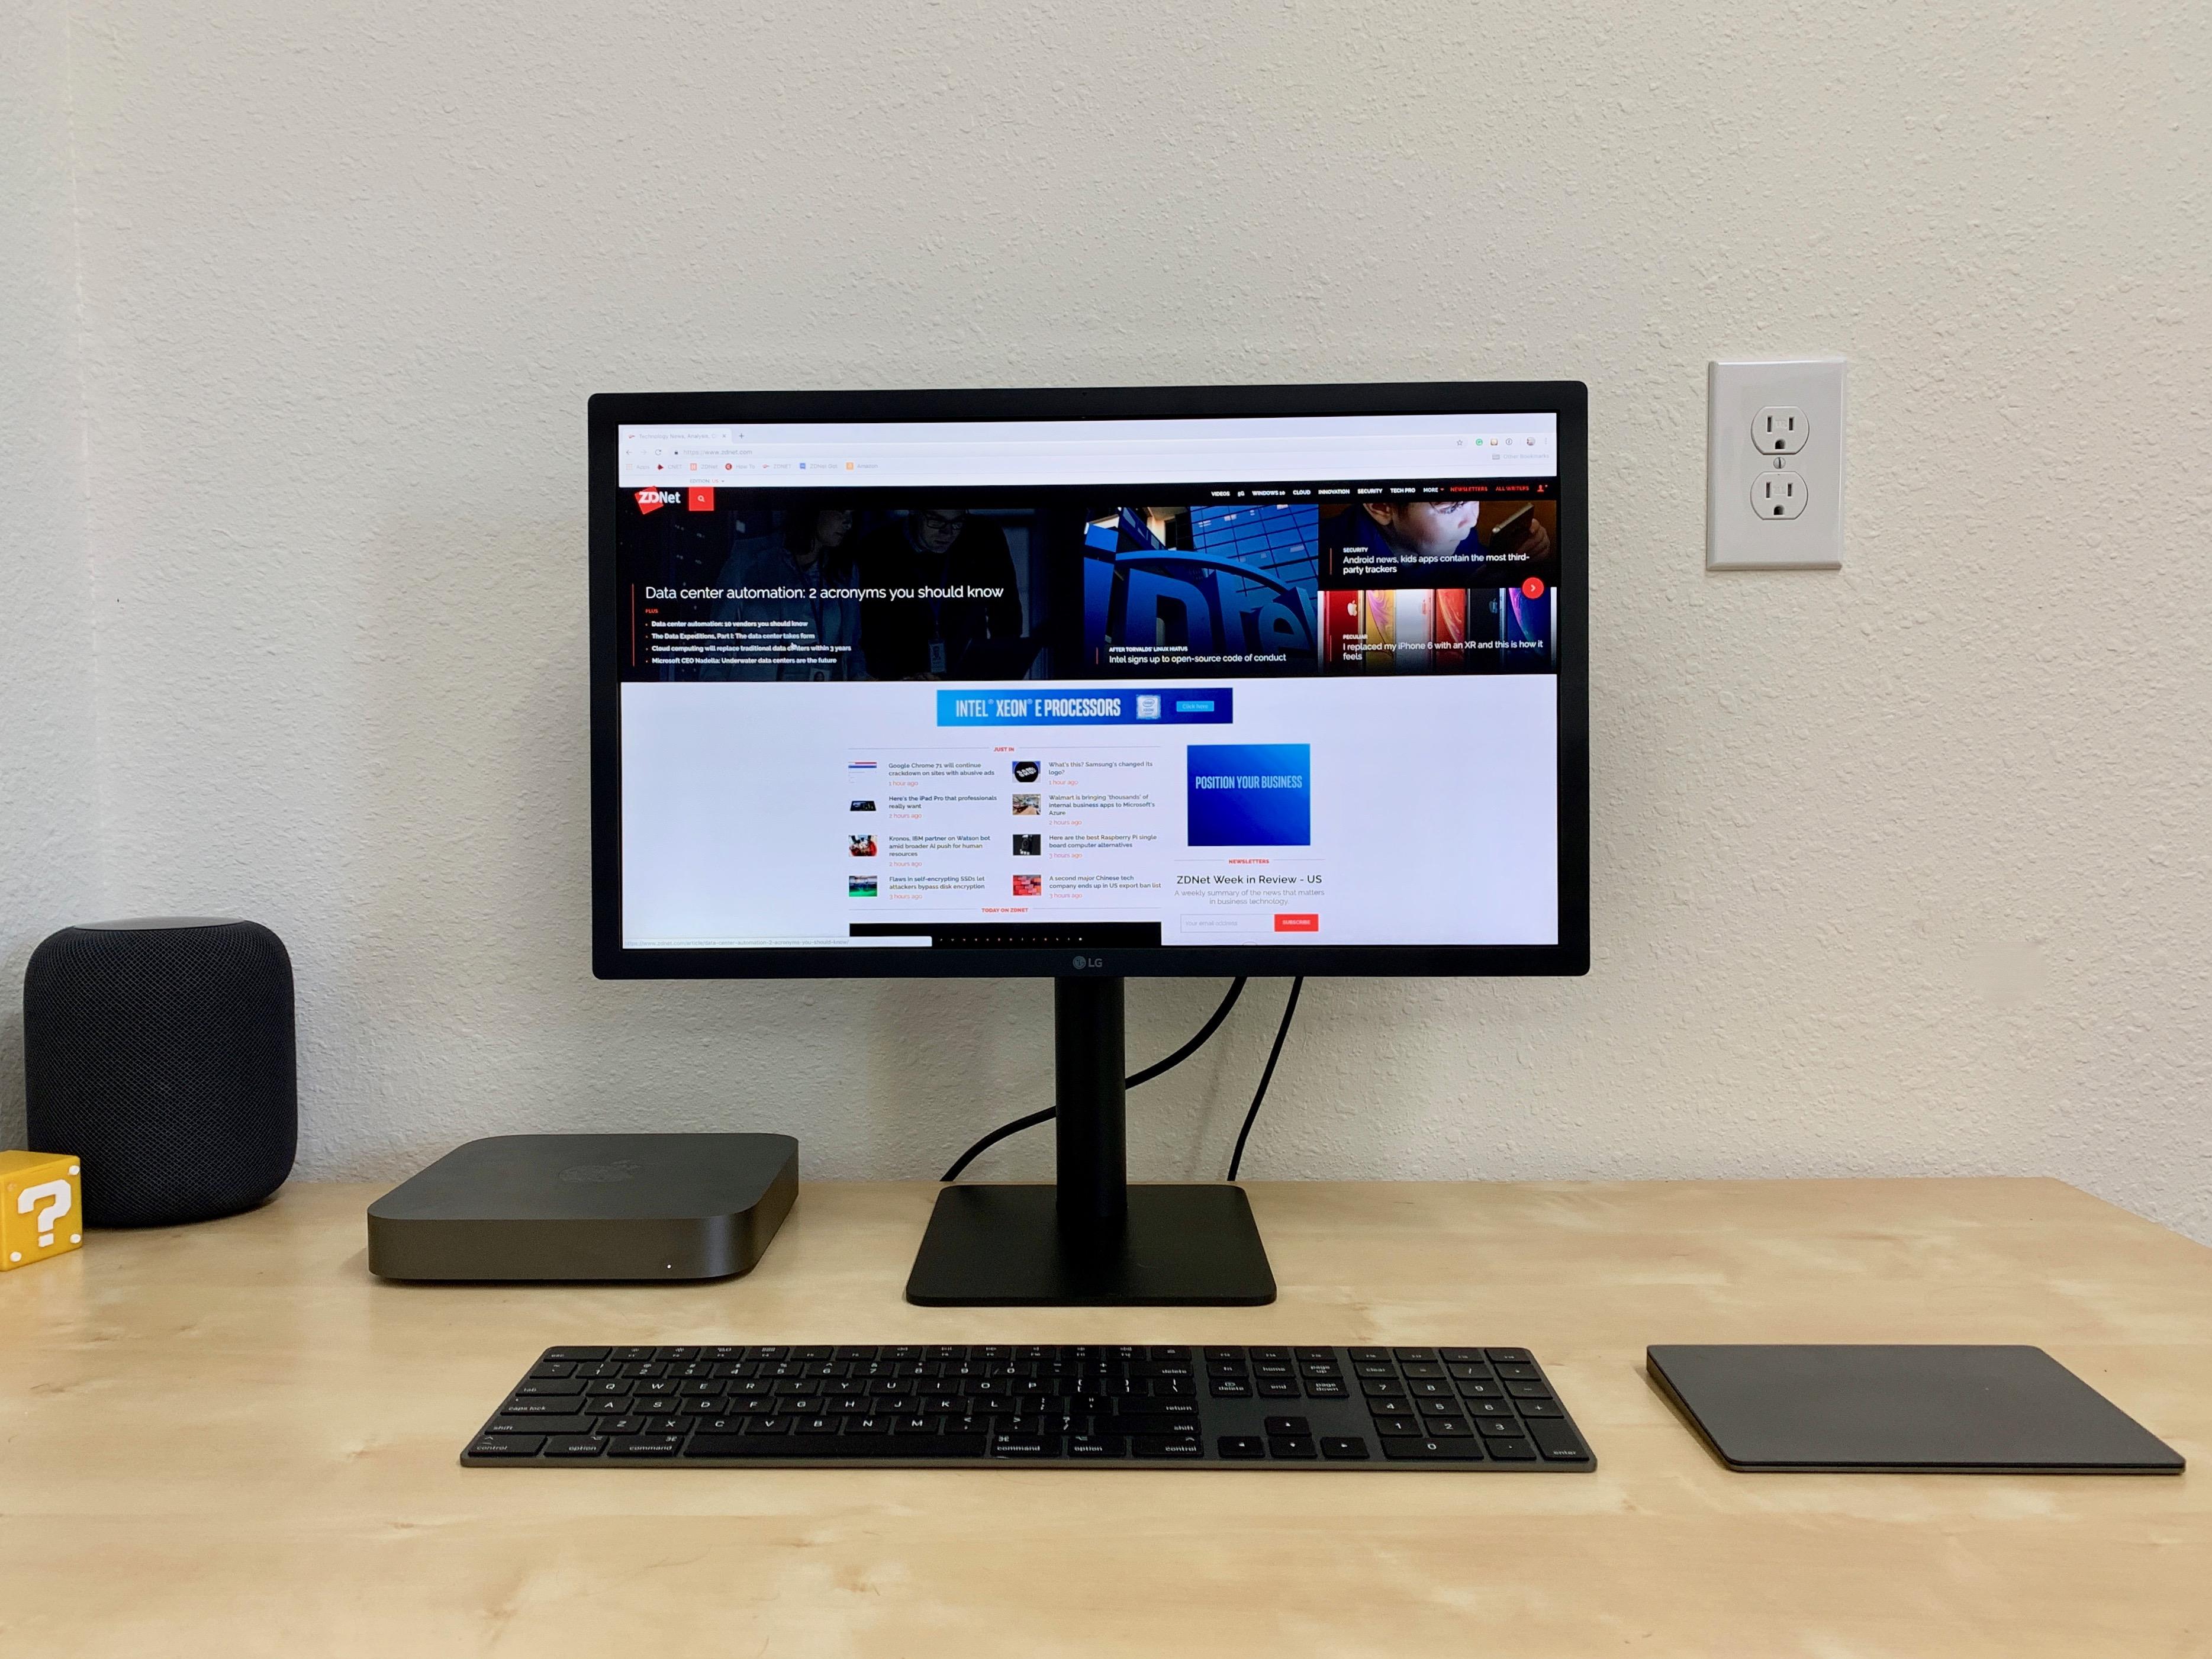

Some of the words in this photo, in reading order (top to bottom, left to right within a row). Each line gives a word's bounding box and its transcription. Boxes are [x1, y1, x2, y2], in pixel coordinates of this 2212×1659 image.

[637, 490, 681, 504] ZDNet
[1342, 555, 1374, 564] Android
[1376, 556, 1399, 565] news,
[1400, 554, 1417, 563] kids
[1418, 556, 1438, 564] apps
[1439, 553, 1470, 562] contain
[1470, 553, 1485, 562] the
[1507, 552, 1530, 561] third-
[1342, 565, 1364, 575] party
[1364, 565, 1398, 574] trackers
[645, 586, 677, 599] Data
[680, 587, 724, 599] center
[726, 585, 806, 599] automation:
[809, 588, 817, 599] 2
[820, 588, 887, 602] acronyms
[888, 588, 915, 601] you
[917, 585, 964, 598] should
[967, 585, 1004, 598] know
[1347, 642, 1382, 651] replaced
[1383, 643, 1397, 652] my
[1434, 641, 1451, 649] with
[1464, 640, 1476, 649] XR
[1477, 640, 1493, 649] and
[1494, 640, 1509, 649] this
[1510, 640, 1518, 648] is
[1518, 639, 1537, 648] how
[1537, 639, 1543, 648] it
[1109, 655, 1126, 663] Intel
[1127, 655, 1148, 665] signs
[1149, 656, 1161, 664] up
[1161, 655, 1170, 663] to
[1171, 655, 1221, 664] open-source
[1222, 653, 1243, 662] code
[1244, 653, 1253, 662] of
[1253, 653, 1286, 662] conduct
[1342, 650, 1363, 661] feels
[1035, 698, 1042, 717] E
[1044, 698, 1121, 717] PROCESSORS
[1195, 775, 1235, 789] POSITION
[1236, 775, 1260, 789] YOUR
[1261, 775, 1302, 788] BUSINESS
[1176, 875, 1210, 884] ZDNet
[1213, 875, 1244, 884] Week
[1246, 875, 1255, 884] in
[1258, 875, 1297, 884] Review
[1307, 874, 1322, 884] US
[1087, 957, 1103, 968] LG
[17, 1179, 72, 1247] ?
